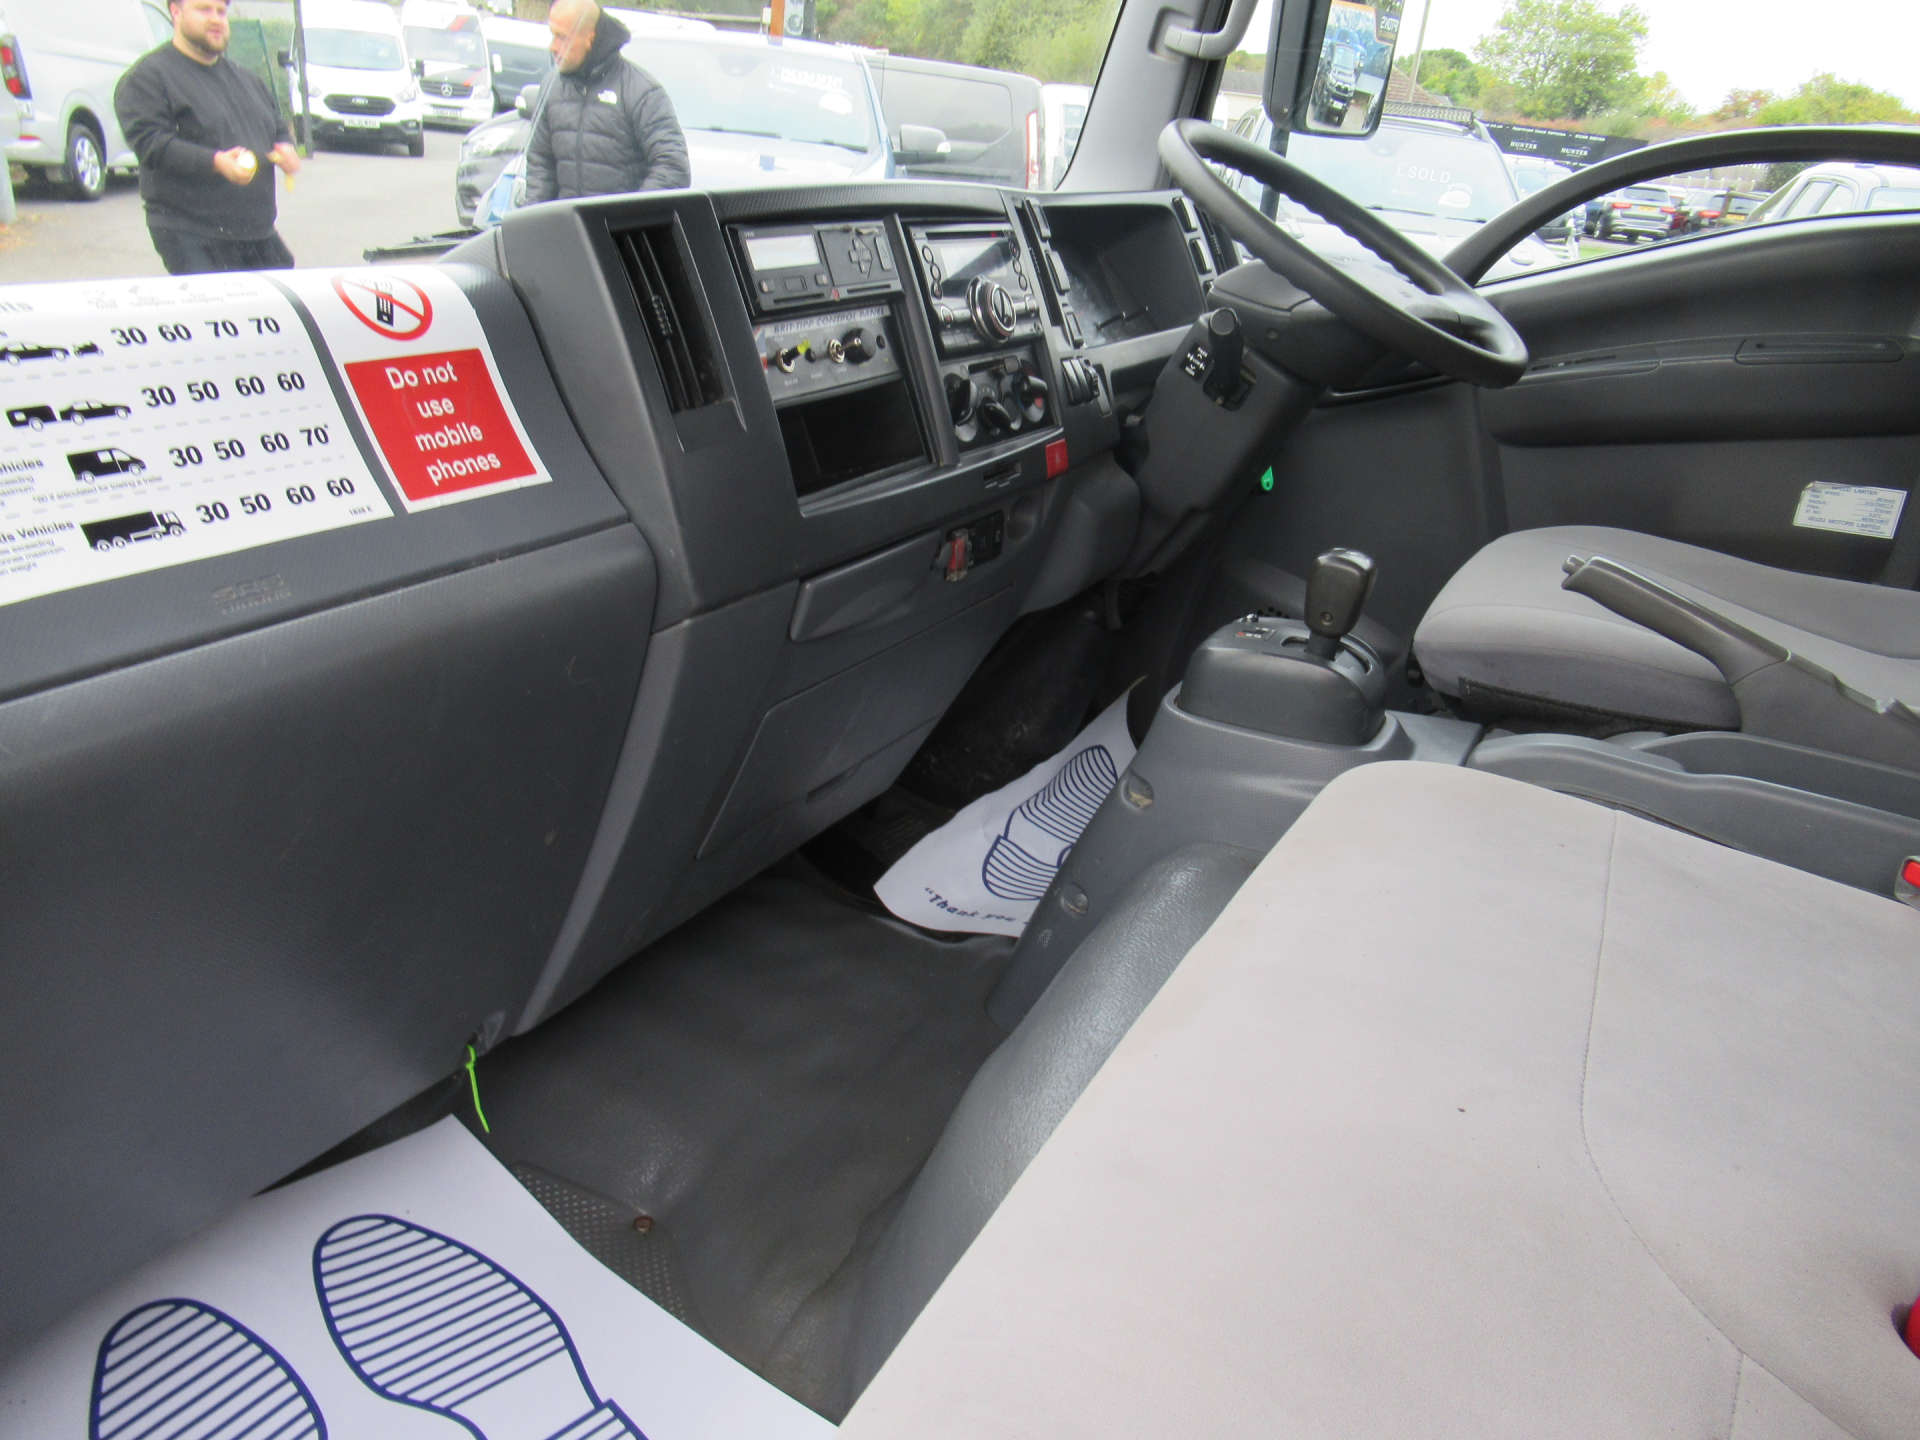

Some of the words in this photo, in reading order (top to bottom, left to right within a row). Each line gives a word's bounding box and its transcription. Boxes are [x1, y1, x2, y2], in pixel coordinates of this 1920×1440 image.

[1407, 165, 1451, 184] SOLD
[110, 327, 148, 346] 30
[157, 324, 193, 342] 60
[205, 320, 240, 338] 70
[248, 317, 281, 335] 70
[141, 385, 177, 408] 30
[187, 380, 220, 403] 50
[234, 375, 266, 397] 60
[276, 371, 306, 392] 60
[385, 366, 419, 390] Do
[422, 361, 458, 385] not
[416, 397, 455, 419] use
[168, 445, 203, 468] 30
[213, 439, 246, 461] 50
[260, 432, 290, 453] 60
[415, 421, 483, 452] mobile
[426, 453, 501, 487] phones
[195, 501, 230, 524] 30
[239, 493, 272, 515] 50
[285, 485, 316, 505] 60
[326, 477, 355, 497] 60
[16, 521, 75, 539] Vehicles
